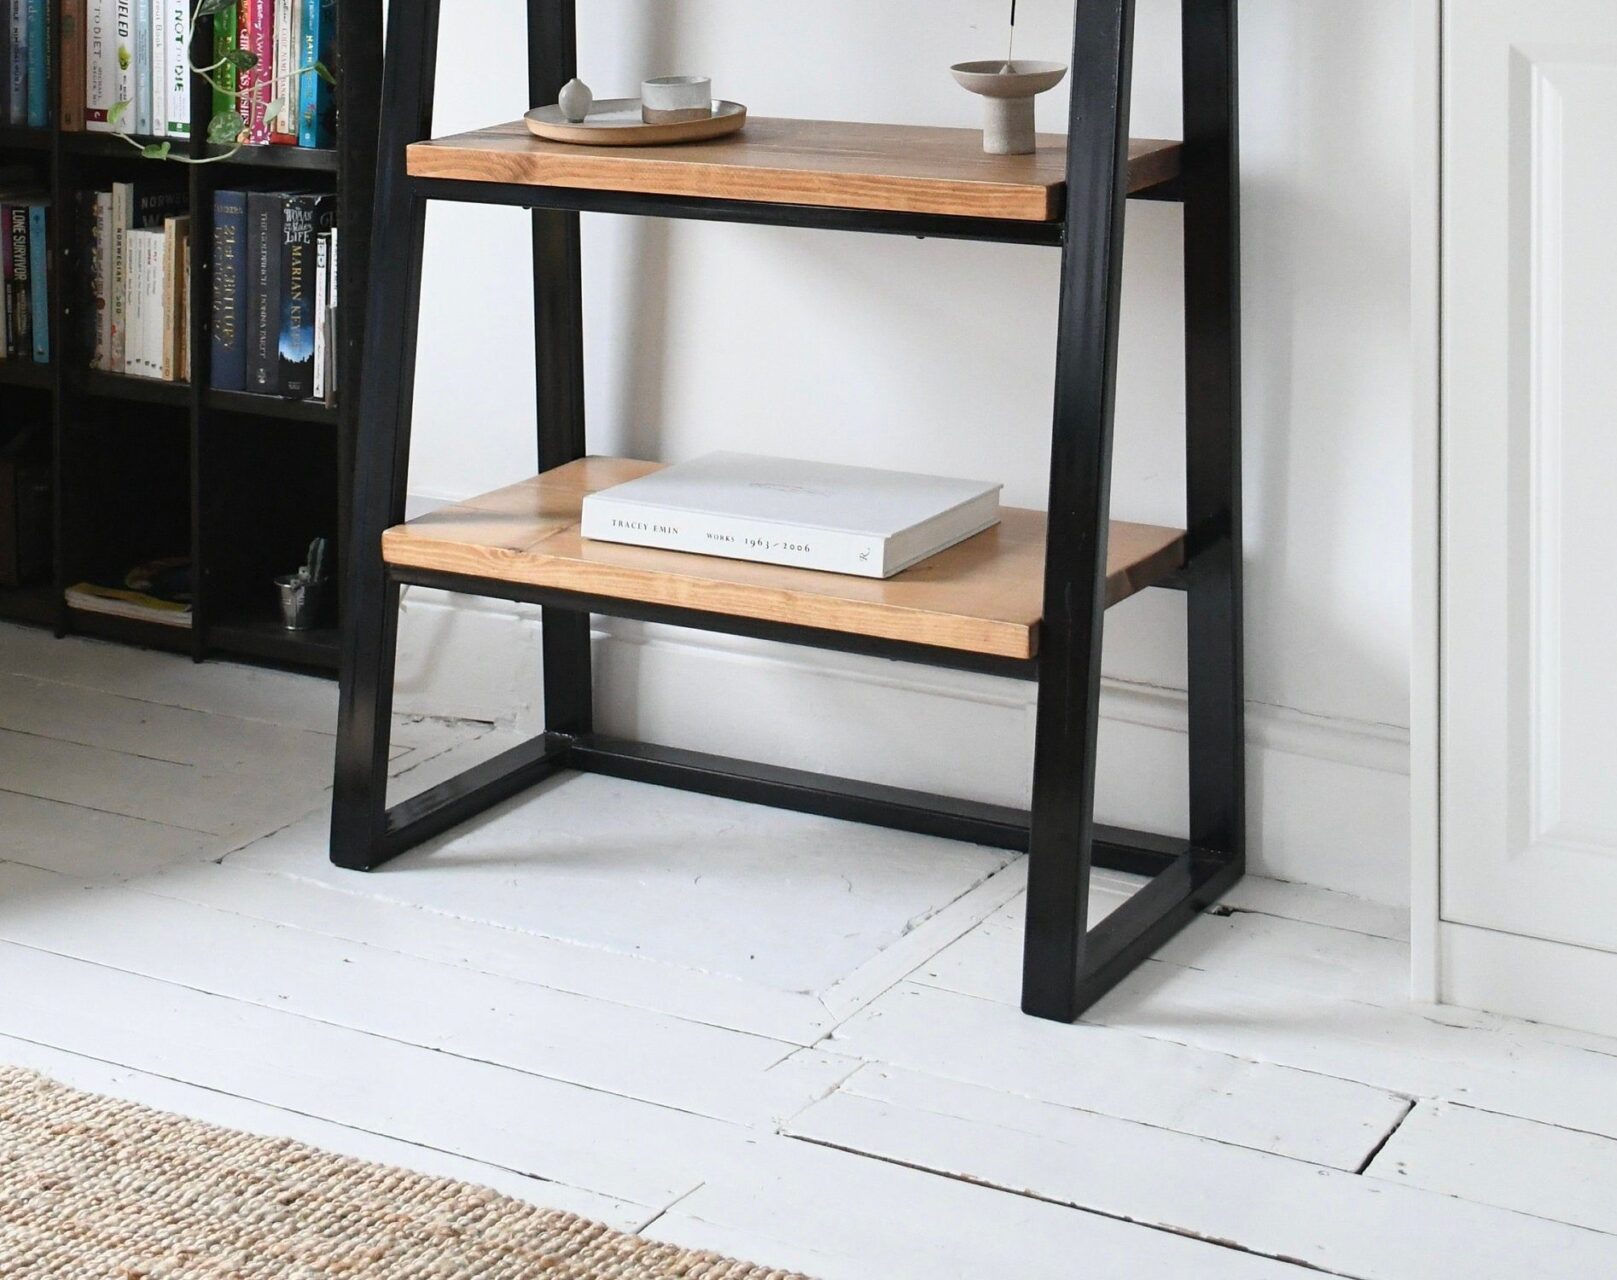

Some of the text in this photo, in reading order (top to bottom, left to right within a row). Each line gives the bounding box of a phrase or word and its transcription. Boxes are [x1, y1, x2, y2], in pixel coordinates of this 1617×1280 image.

[93, 7, 101, 24] TO
[174, 9, 184, 45] NOT
[92, 26, 102, 59] DIET
[155, 24, 164, 48] Book
[280, 52, 288, 72] NAME
[174, 65, 184, 93] DIE
[12, 210, 25, 233] LONE
[260, 213, 268, 286] THE GOLDFINCH
[283, 231, 311, 245] LIFE
[14, 235, 27, 280] SURVIVOR
[291, 245, 302, 300] MARIAN
[260, 294, 268, 360] DONNA TARTT
[611, 518, 679, 535] TRACEY EMIN
[706, 532, 736, 543] WORKS
